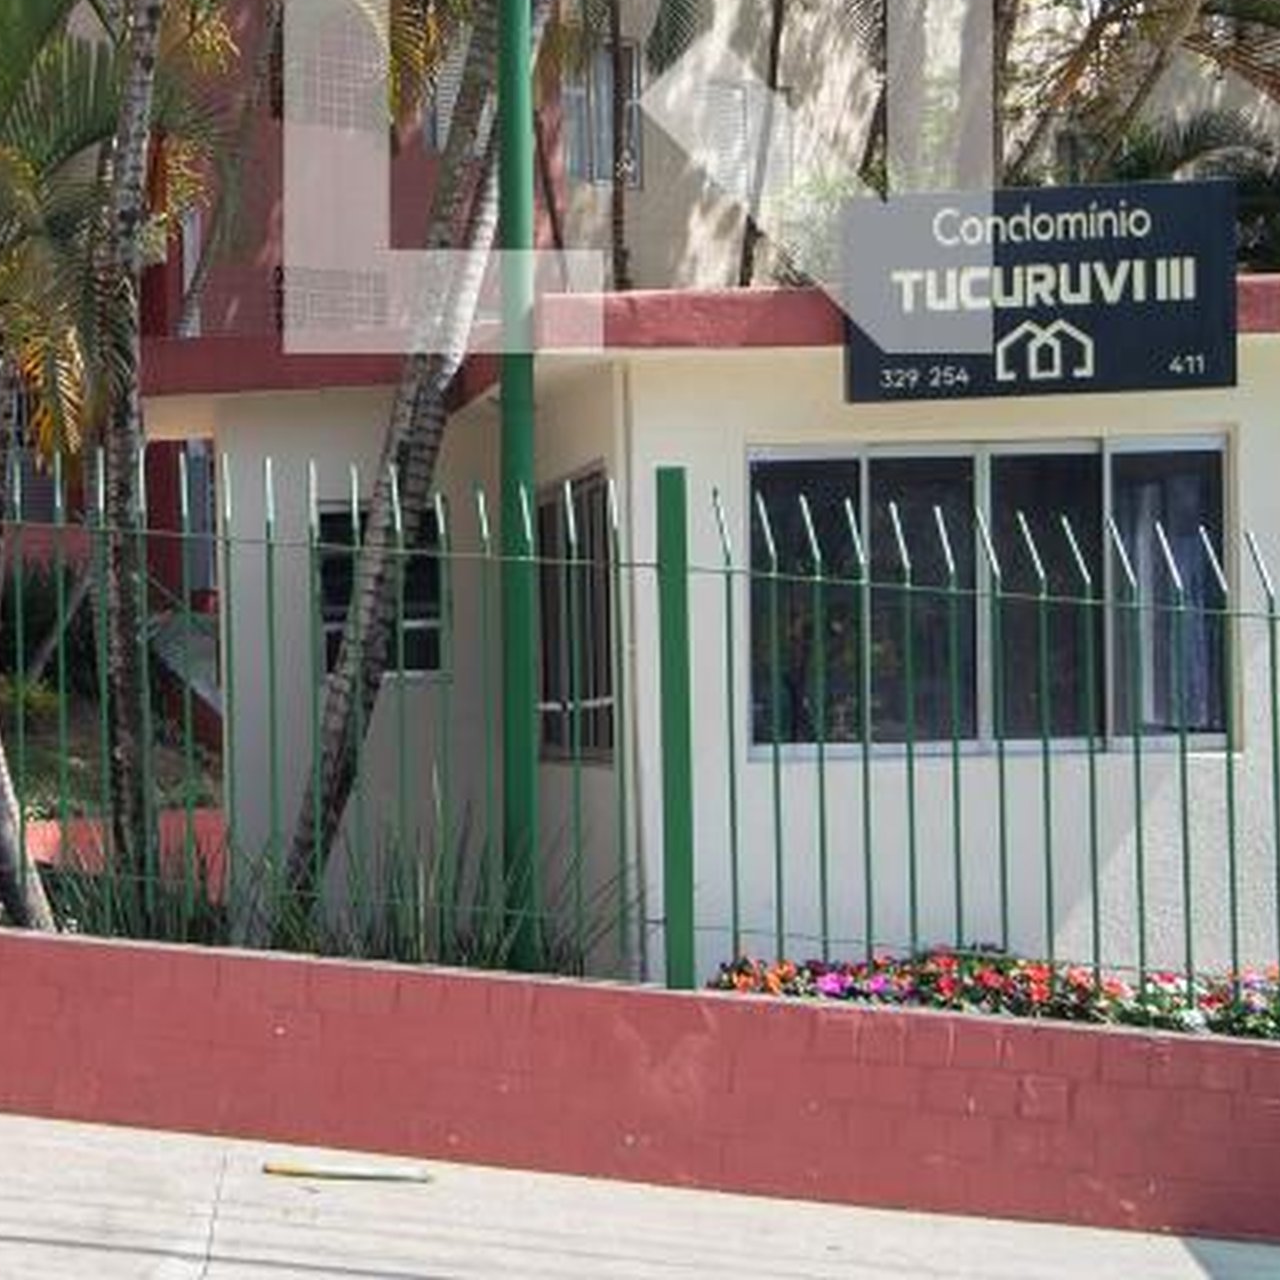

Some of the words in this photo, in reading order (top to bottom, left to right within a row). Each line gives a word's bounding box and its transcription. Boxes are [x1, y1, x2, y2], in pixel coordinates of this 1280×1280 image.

[933, 200, 1151, 247] Condomínio
[891, 259, 1145, 314] TUCURUVI
[1155, 256, 1197, 302] III
[880, 368, 920, 390] 329
[929, 366, 970, 388] 254
[1169, 354, 1205, 375] 411
